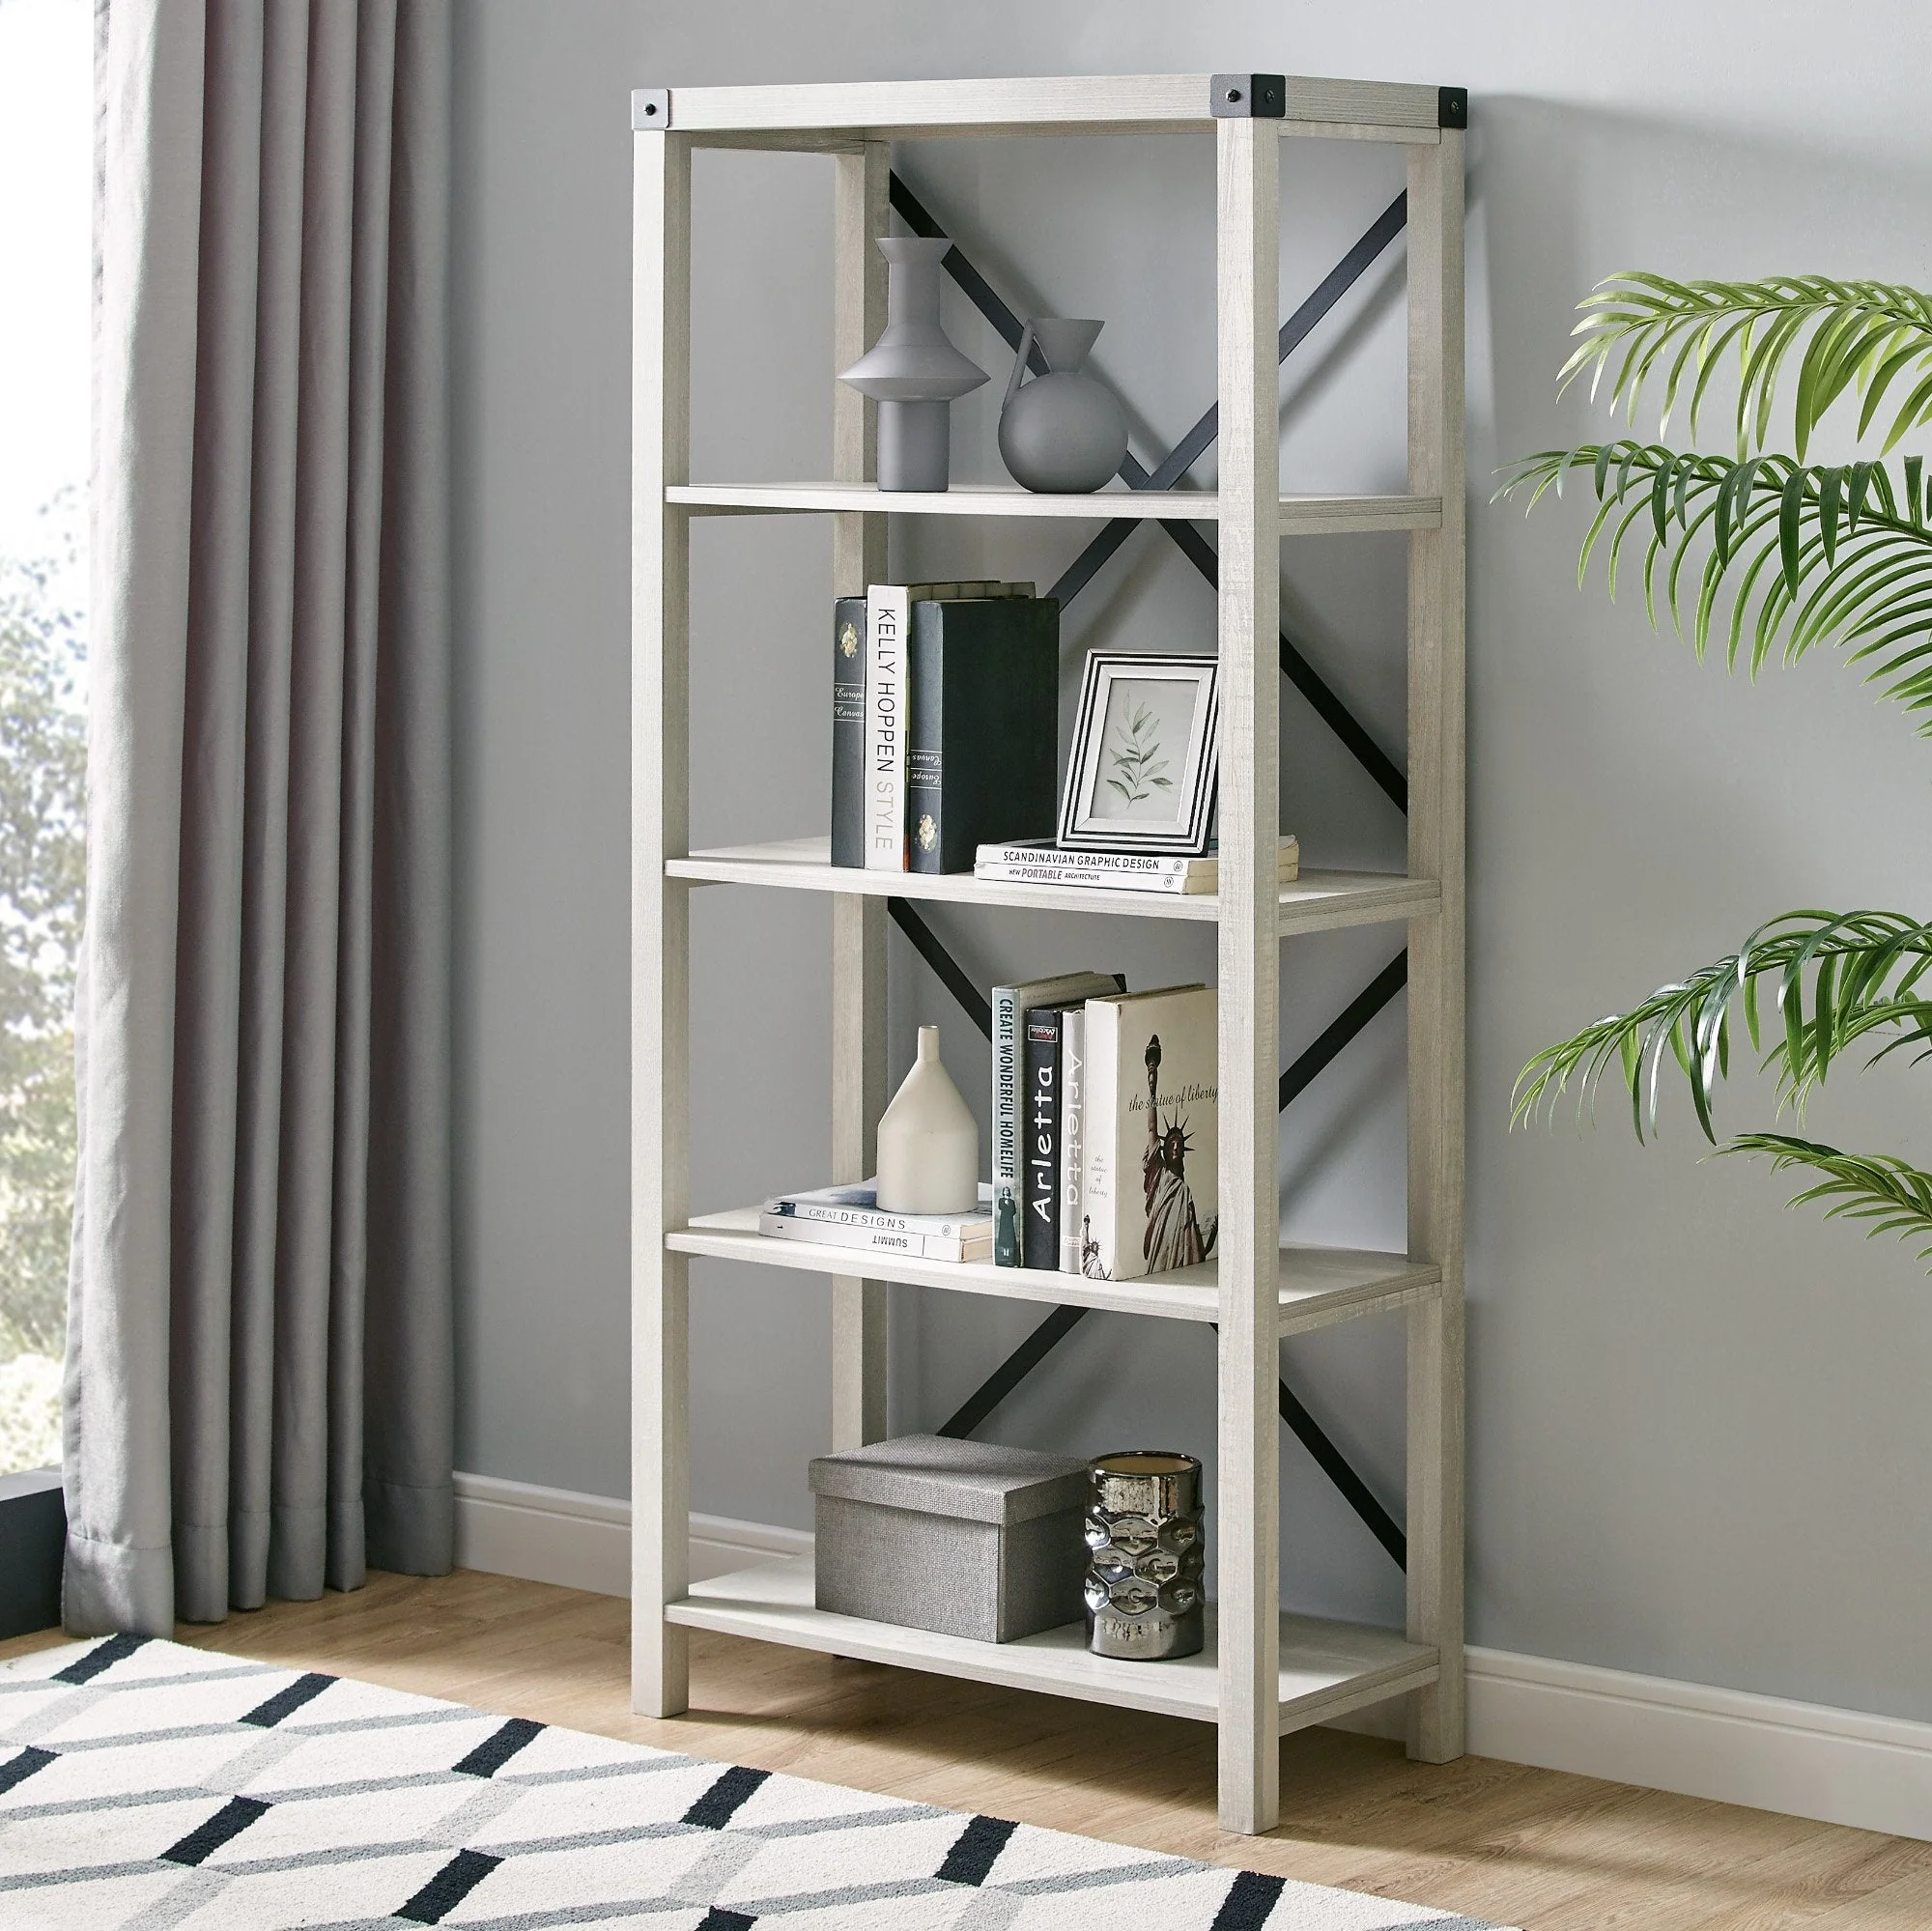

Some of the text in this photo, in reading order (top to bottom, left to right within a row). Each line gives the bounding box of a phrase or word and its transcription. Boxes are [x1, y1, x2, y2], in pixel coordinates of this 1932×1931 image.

[835, 687, 865, 701] Europe
[834, 705, 865, 717] Canvas
[875, 608, 895, 850] KELLY HOPPEN STYLE
[912, 754, 942, 766] Canvas
[912, 771, 942, 785] Europe
[1003, 851, 1160, 869] SCANDINAVIAN GRAPHIC DESIGN
[1021, 867, 1063, 880] PORTABLE
[1065, 872, 1100, 881] ARCHITECTURE
[999, 998, 1014, 1178] CREATE WONDERFUL HOMELIFE
[1128, 1093, 1144, 1112] the
[1175, 1085, 1187, 1110] of
[1187, 1083, 1218, 1104] liberty
[1066, 1048, 1083, 1207] Arletta
[1031, 1065, 1054, 1223] Arletta
[808, 1208, 906, 1230] GREAT DESIGNS
[871, 1235, 908, 1248] SUMMIT
